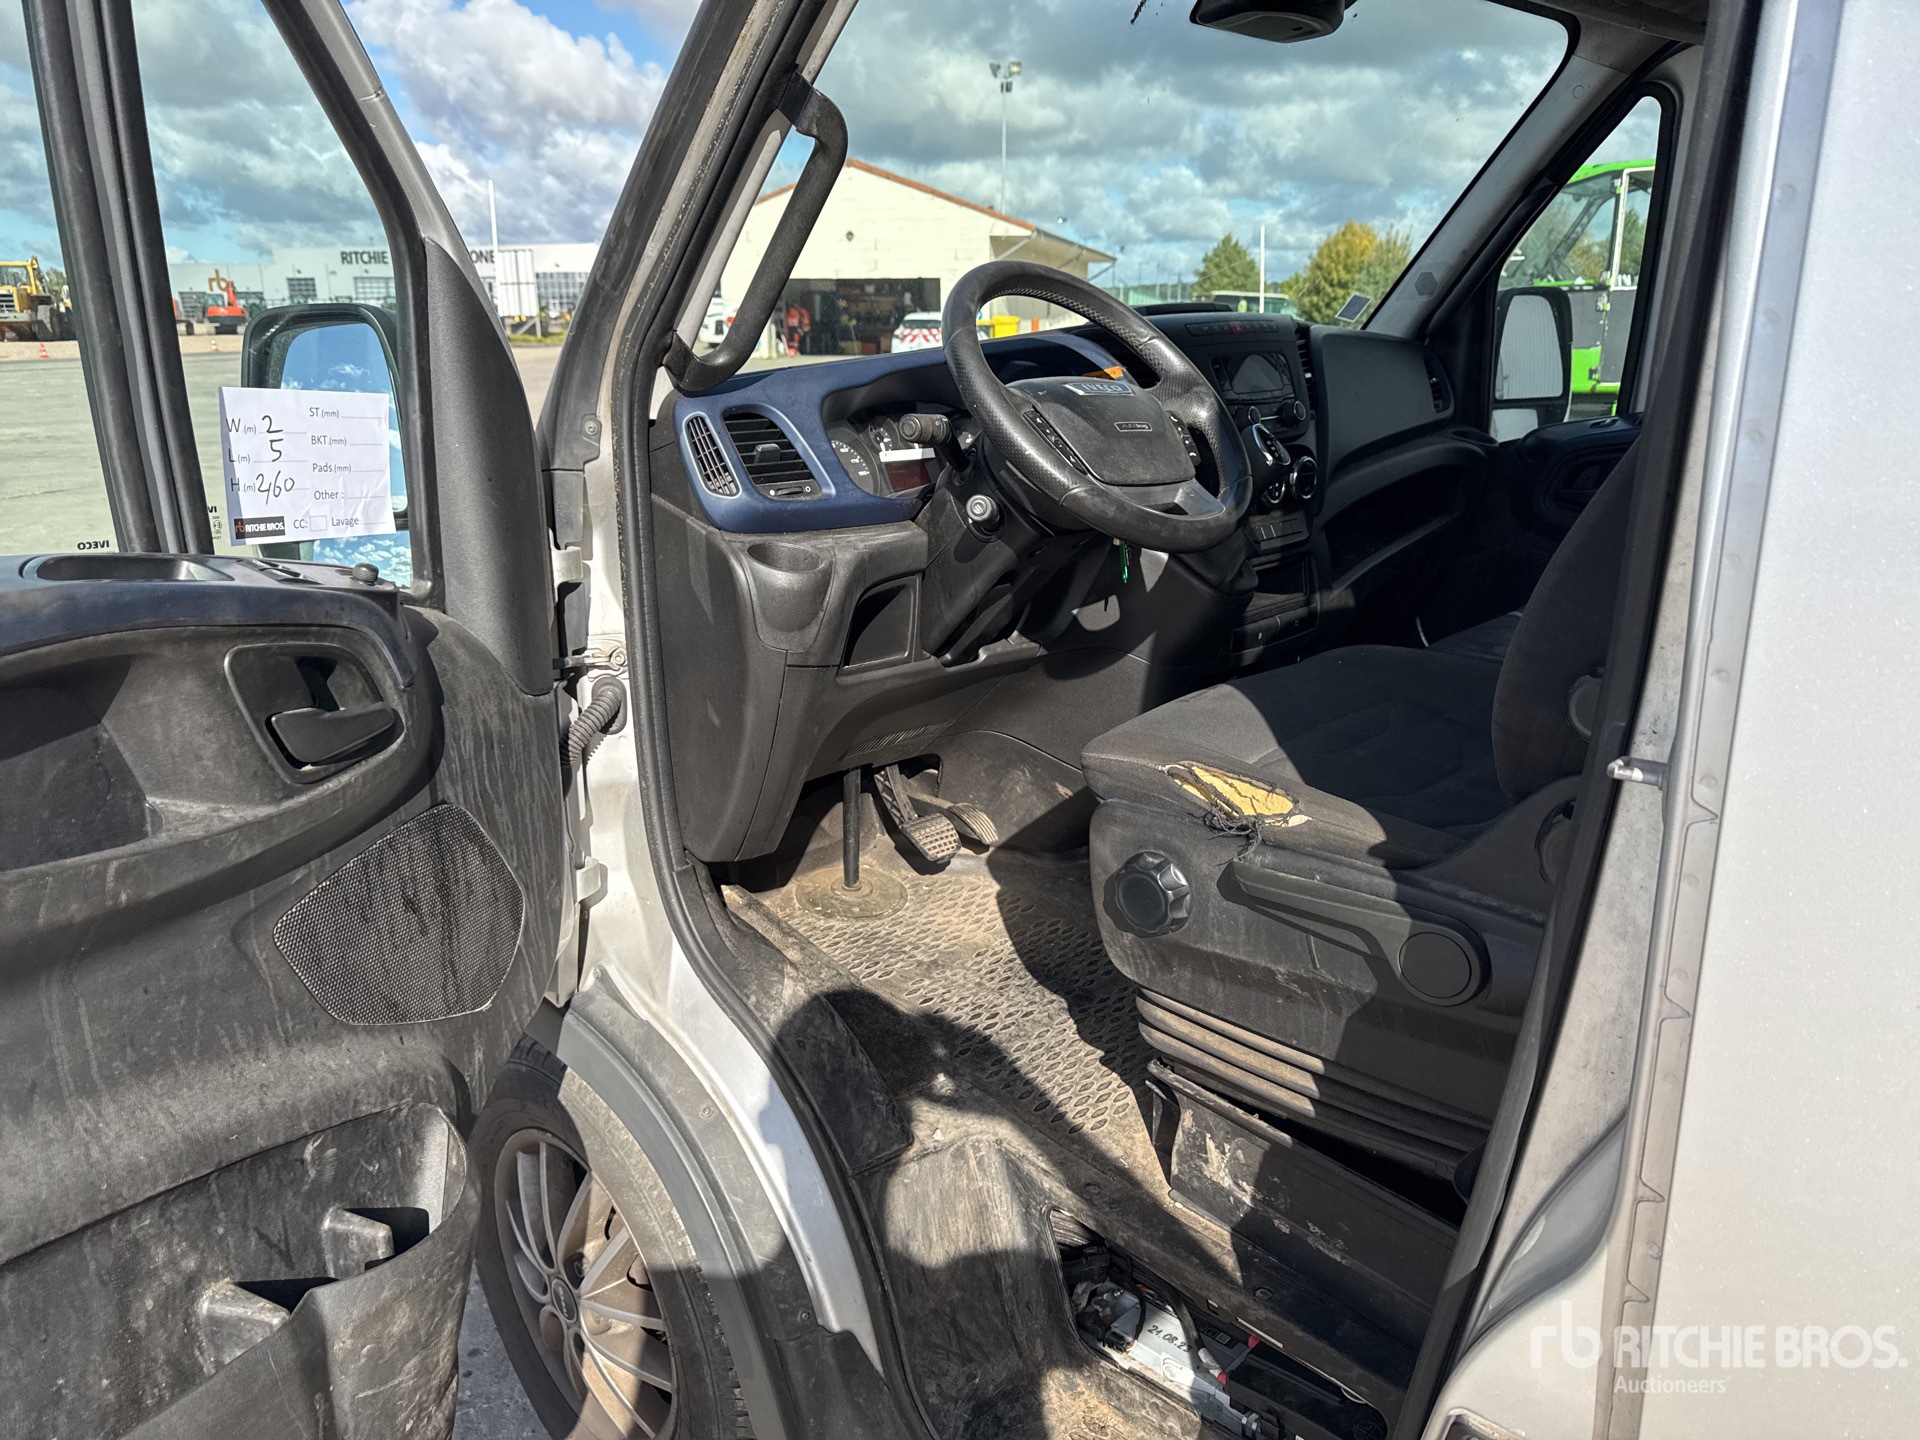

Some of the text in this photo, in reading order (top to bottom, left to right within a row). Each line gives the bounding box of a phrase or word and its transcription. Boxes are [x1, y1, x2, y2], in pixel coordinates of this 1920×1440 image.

[340, 250, 389, 264] RITCHIE
[1081, 383, 1123, 392] IVECO
[262, 415, 284, 434] 2
[269, 438, 284, 462] 5
[245, 523, 267, 533] RITCHIE
